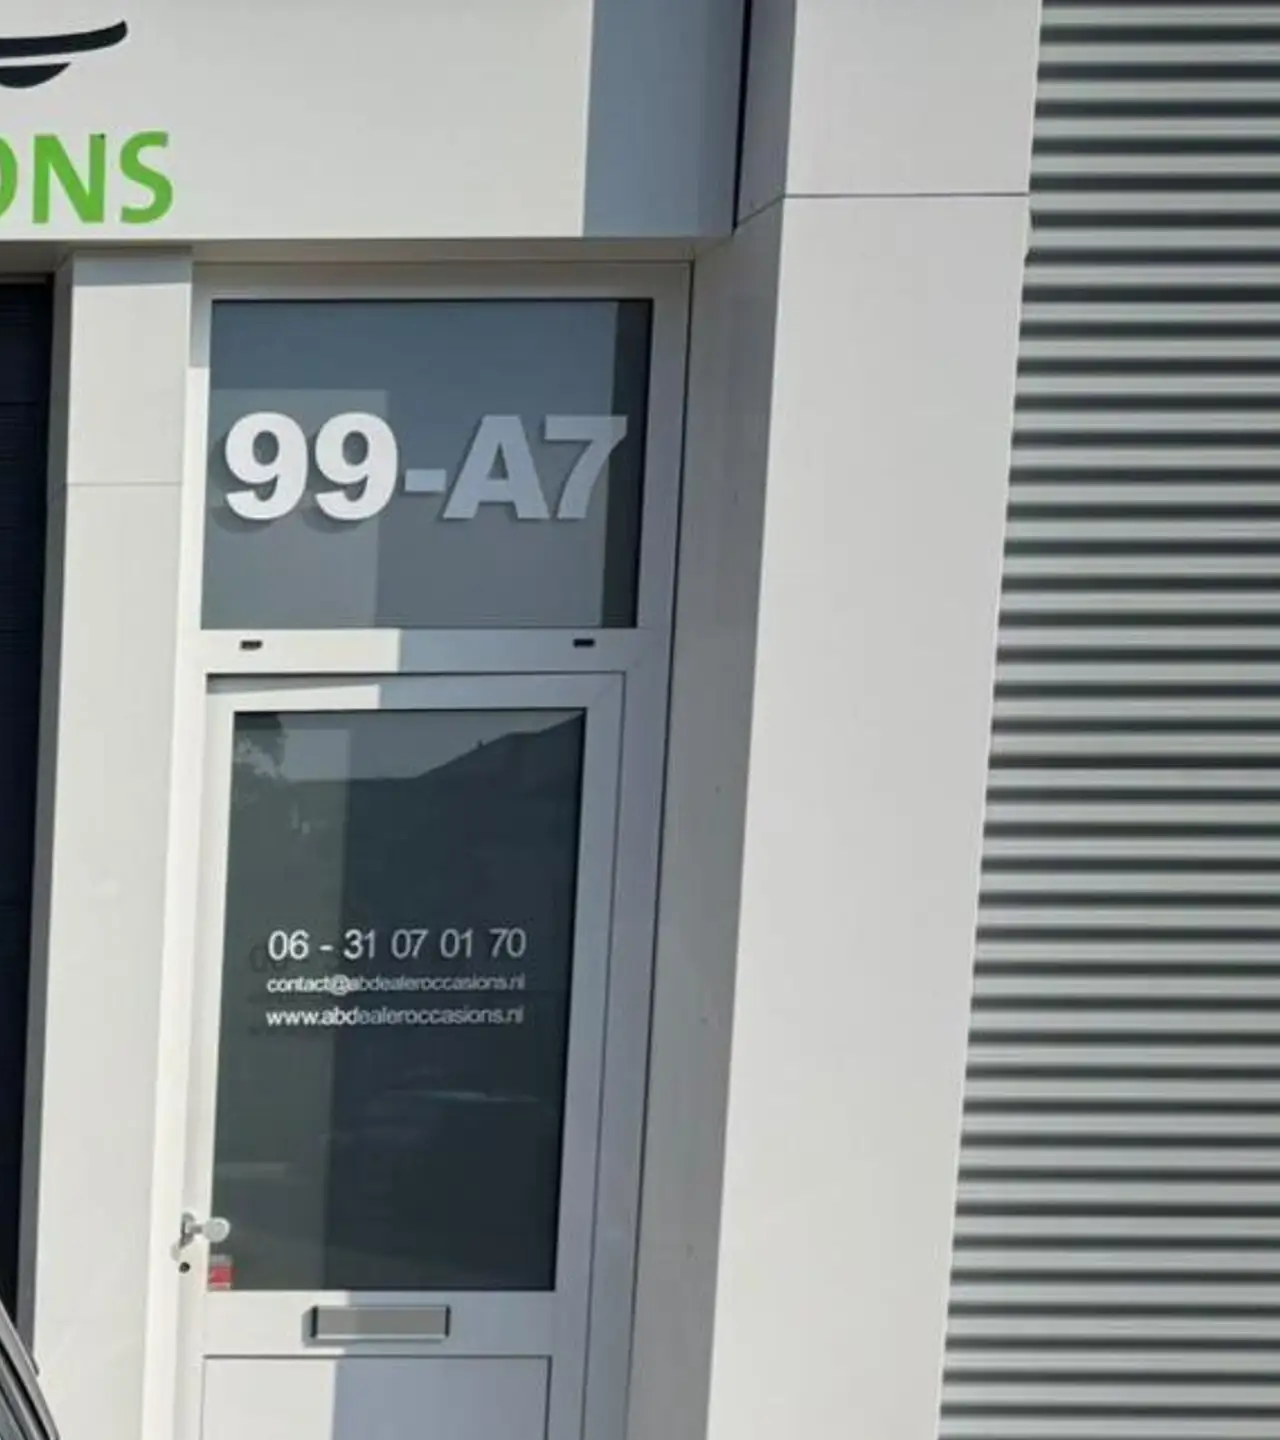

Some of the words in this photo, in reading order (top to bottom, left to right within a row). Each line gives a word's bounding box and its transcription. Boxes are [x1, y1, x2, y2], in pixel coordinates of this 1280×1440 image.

[224, 411, 628, 522] 99-A7
[267, 929, 310, 961] 06
[343, 929, 377, 960] 31
[391, 929, 430, 959] 07
[439, 929, 474, 959] 01
[489, 928, 527, 958] 70
[266, 973, 526, 997] contact@abdealeroccasions.nl
[265, 1005, 525, 1027] www.abdealeroccasions.nl
